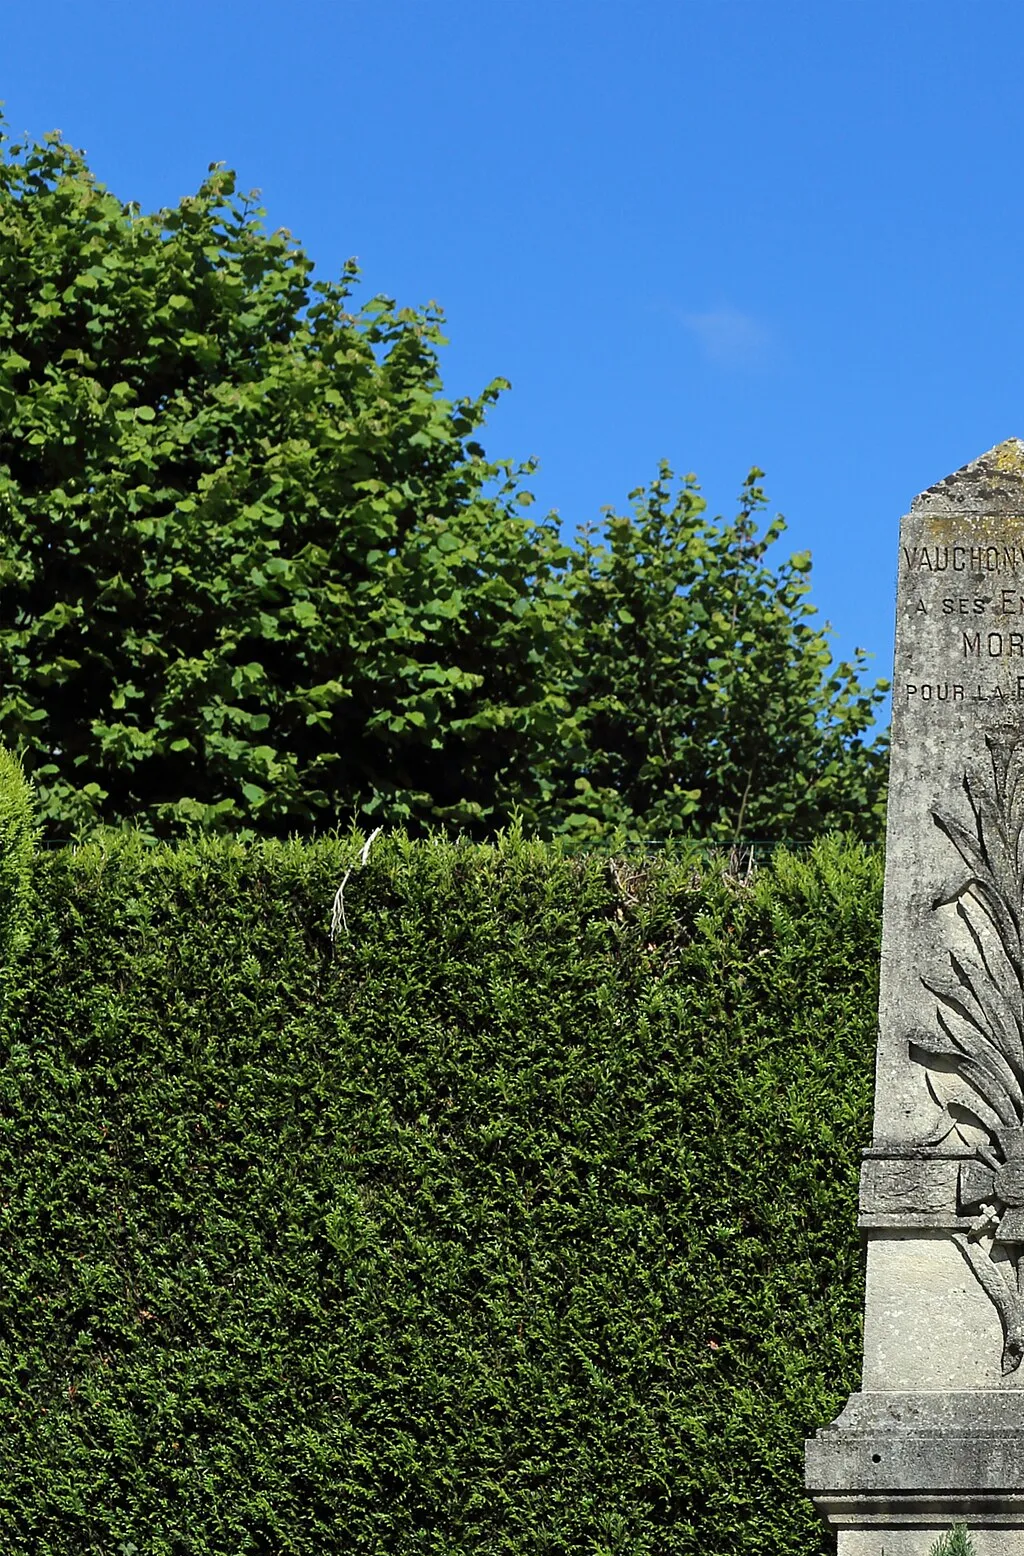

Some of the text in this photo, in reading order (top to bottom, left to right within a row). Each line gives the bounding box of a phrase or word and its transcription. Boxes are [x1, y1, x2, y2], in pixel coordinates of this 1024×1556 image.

[916, 599, 927, 614] A
[942, 598, 986, 615] SES
[906, 684, 965, 701] POUR
[977, 685, 1005, 701] LA
